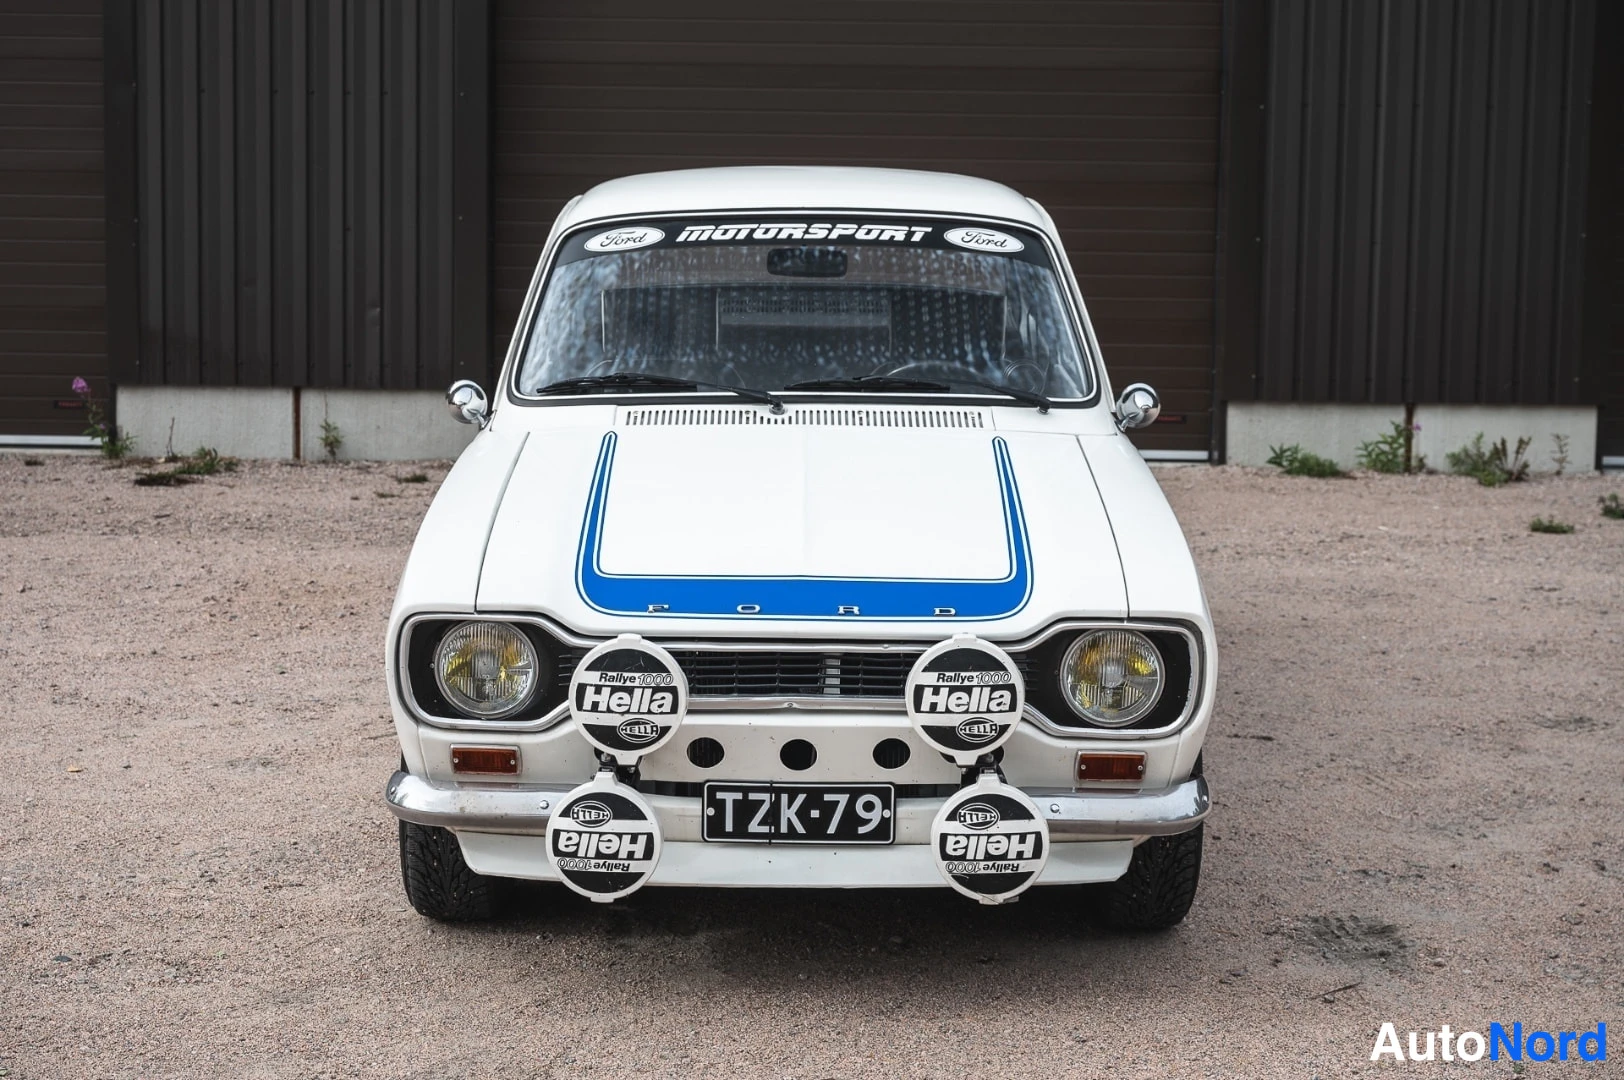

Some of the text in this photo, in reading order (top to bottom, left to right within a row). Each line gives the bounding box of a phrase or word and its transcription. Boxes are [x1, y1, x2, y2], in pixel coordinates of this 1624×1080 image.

[600, 230, 647, 248] Ford
[675, 223, 933, 242] MOTORSPORT
[960, 230, 1008, 249] Ford
[599, 672, 674, 685] Rallye 1000
[936, 671, 1012, 685] Rallye 1000
[582, 685, 674, 714] Hella
[920, 686, 1012, 713] Hella
[620, 723, 659, 736] HELLA
[959, 722, 998, 735] HELLA
[571, 807, 609, 821] HELLA
[715, 791, 883, 835] TZK-79
[958, 810, 997, 824] HELLA
[557, 831, 648, 859] Hella
[945, 833, 1036, 860] Hella
[556, 858, 631, 872] Rallye 1000
[945, 861, 1020, 873] Rallye 1000
